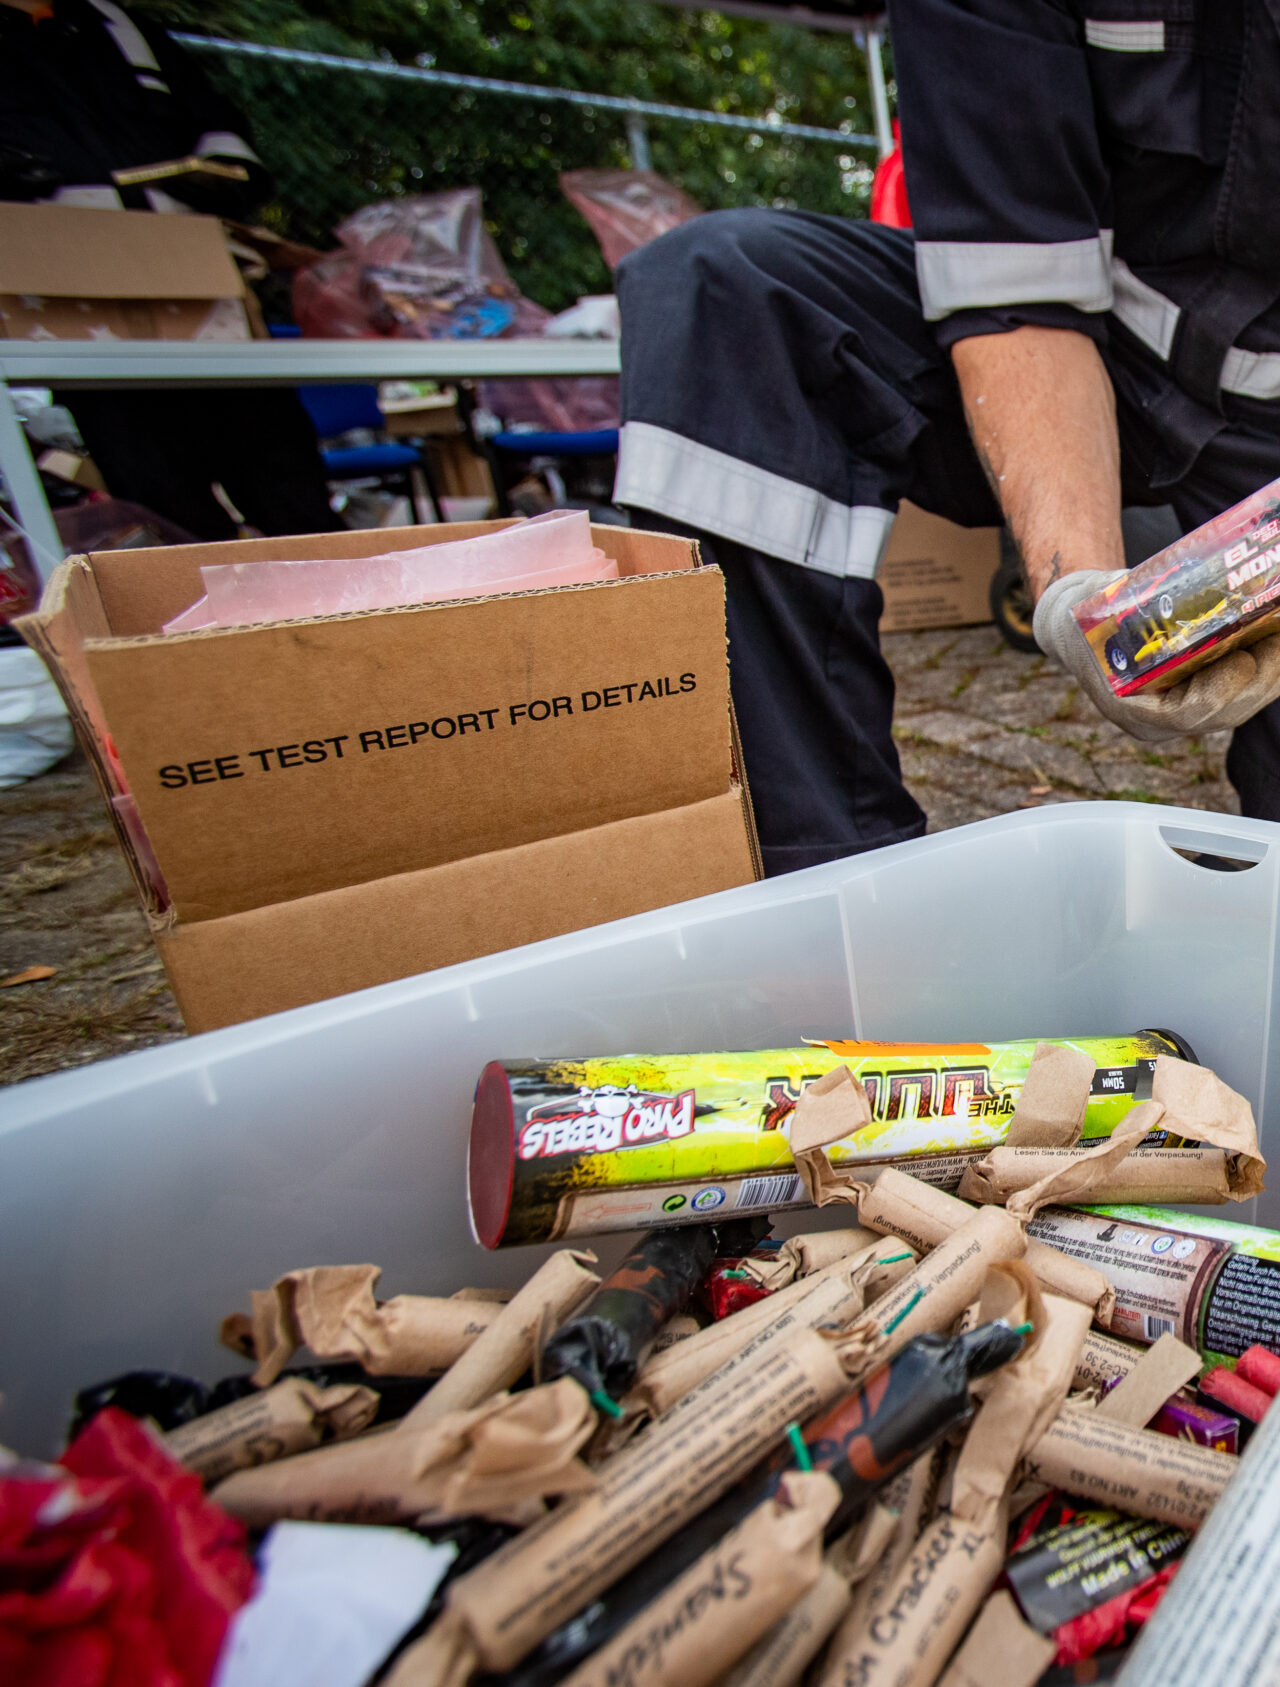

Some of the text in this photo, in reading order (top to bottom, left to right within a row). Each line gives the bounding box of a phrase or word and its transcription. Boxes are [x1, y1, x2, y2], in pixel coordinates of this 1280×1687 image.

[1223, 537, 1258, 569] EL
[1242, 599, 1253, 614] 4
[158, 671, 698, 790] SEE TEST REPORT FOR DETAILS
[1102, 1076, 1124, 1090] 50MM
[966, 1093, 1013, 1118] THE
[520, 1093, 692, 1159] PYRO REBELS
[1155, 1151, 1203, 1160] Verpackung!
[872, 1212, 925, 1249] Verpackung!
[932, 1239, 982, 1286] Verpackung!
[1079, 1557, 1131, 1597] Made
